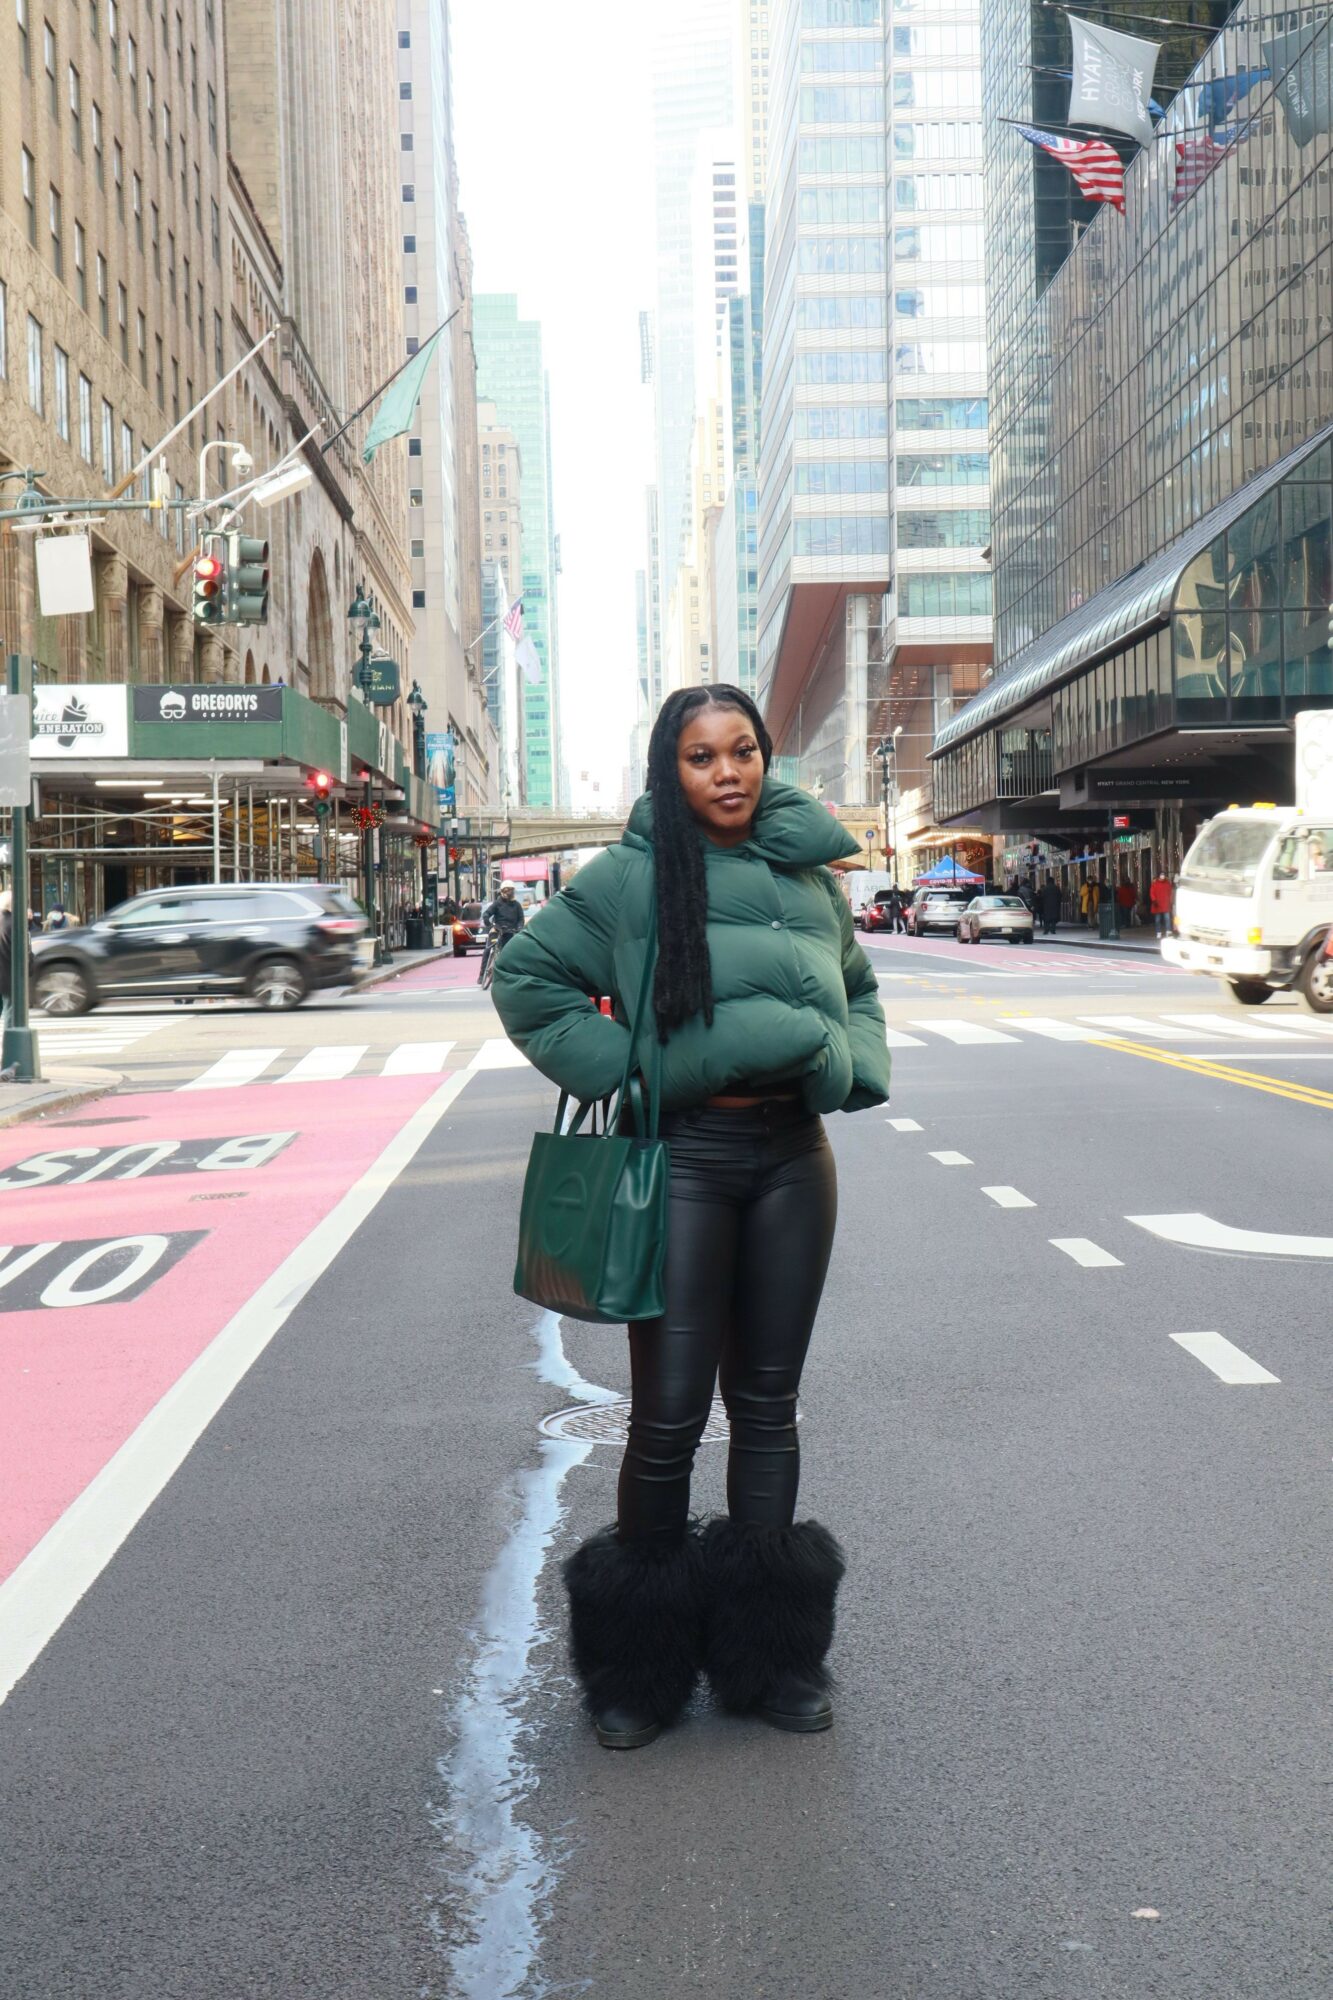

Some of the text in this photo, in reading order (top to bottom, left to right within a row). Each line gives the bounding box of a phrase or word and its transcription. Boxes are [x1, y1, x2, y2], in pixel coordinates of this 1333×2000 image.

[1080, 40, 1102, 101] HYATT
[191, 694, 258, 711] GREGORYS
[38, 723, 102, 734] ENERATION
[0, 1130, 300, 1190] BUS
